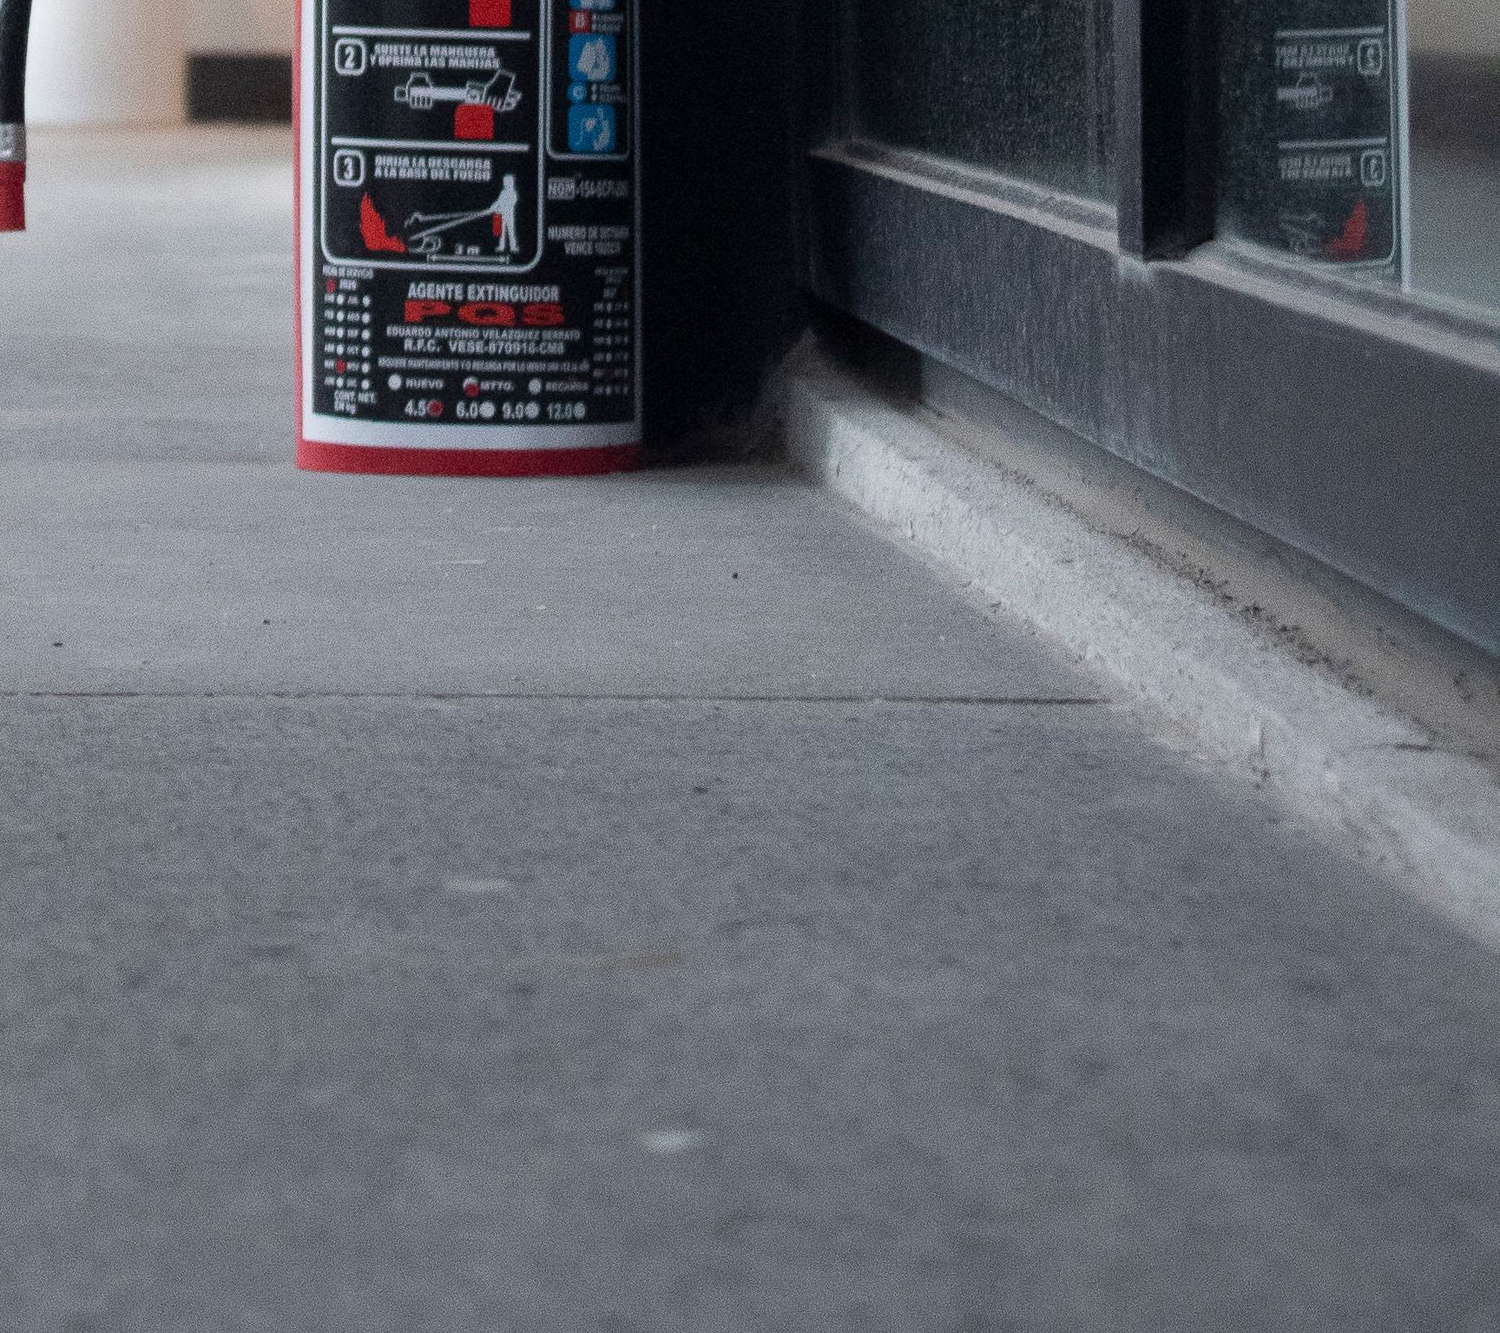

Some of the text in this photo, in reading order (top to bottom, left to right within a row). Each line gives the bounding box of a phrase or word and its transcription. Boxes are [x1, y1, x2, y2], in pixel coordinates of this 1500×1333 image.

[429, 44, 497, 59] MANGUERA
[428, 156, 493, 171] DESCARGA
[452, 168, 492, 182] FUEGO
[407, 282, 560, 303] AGENTE EXTINGUIDOR
[403, 299, 565, 327] PQS
[386, 325, 433, 339] EDUARDO
[434, 327, 480, 340] ANTONIO
[404, 338, 442, 353] R.F.C.
[404, 377, 444, 390] NUEVO
[404, 399, 427, 418] 4.5
[456, 400, 479, 419] 6.0
[502, 401, 525, 419] 9.0
